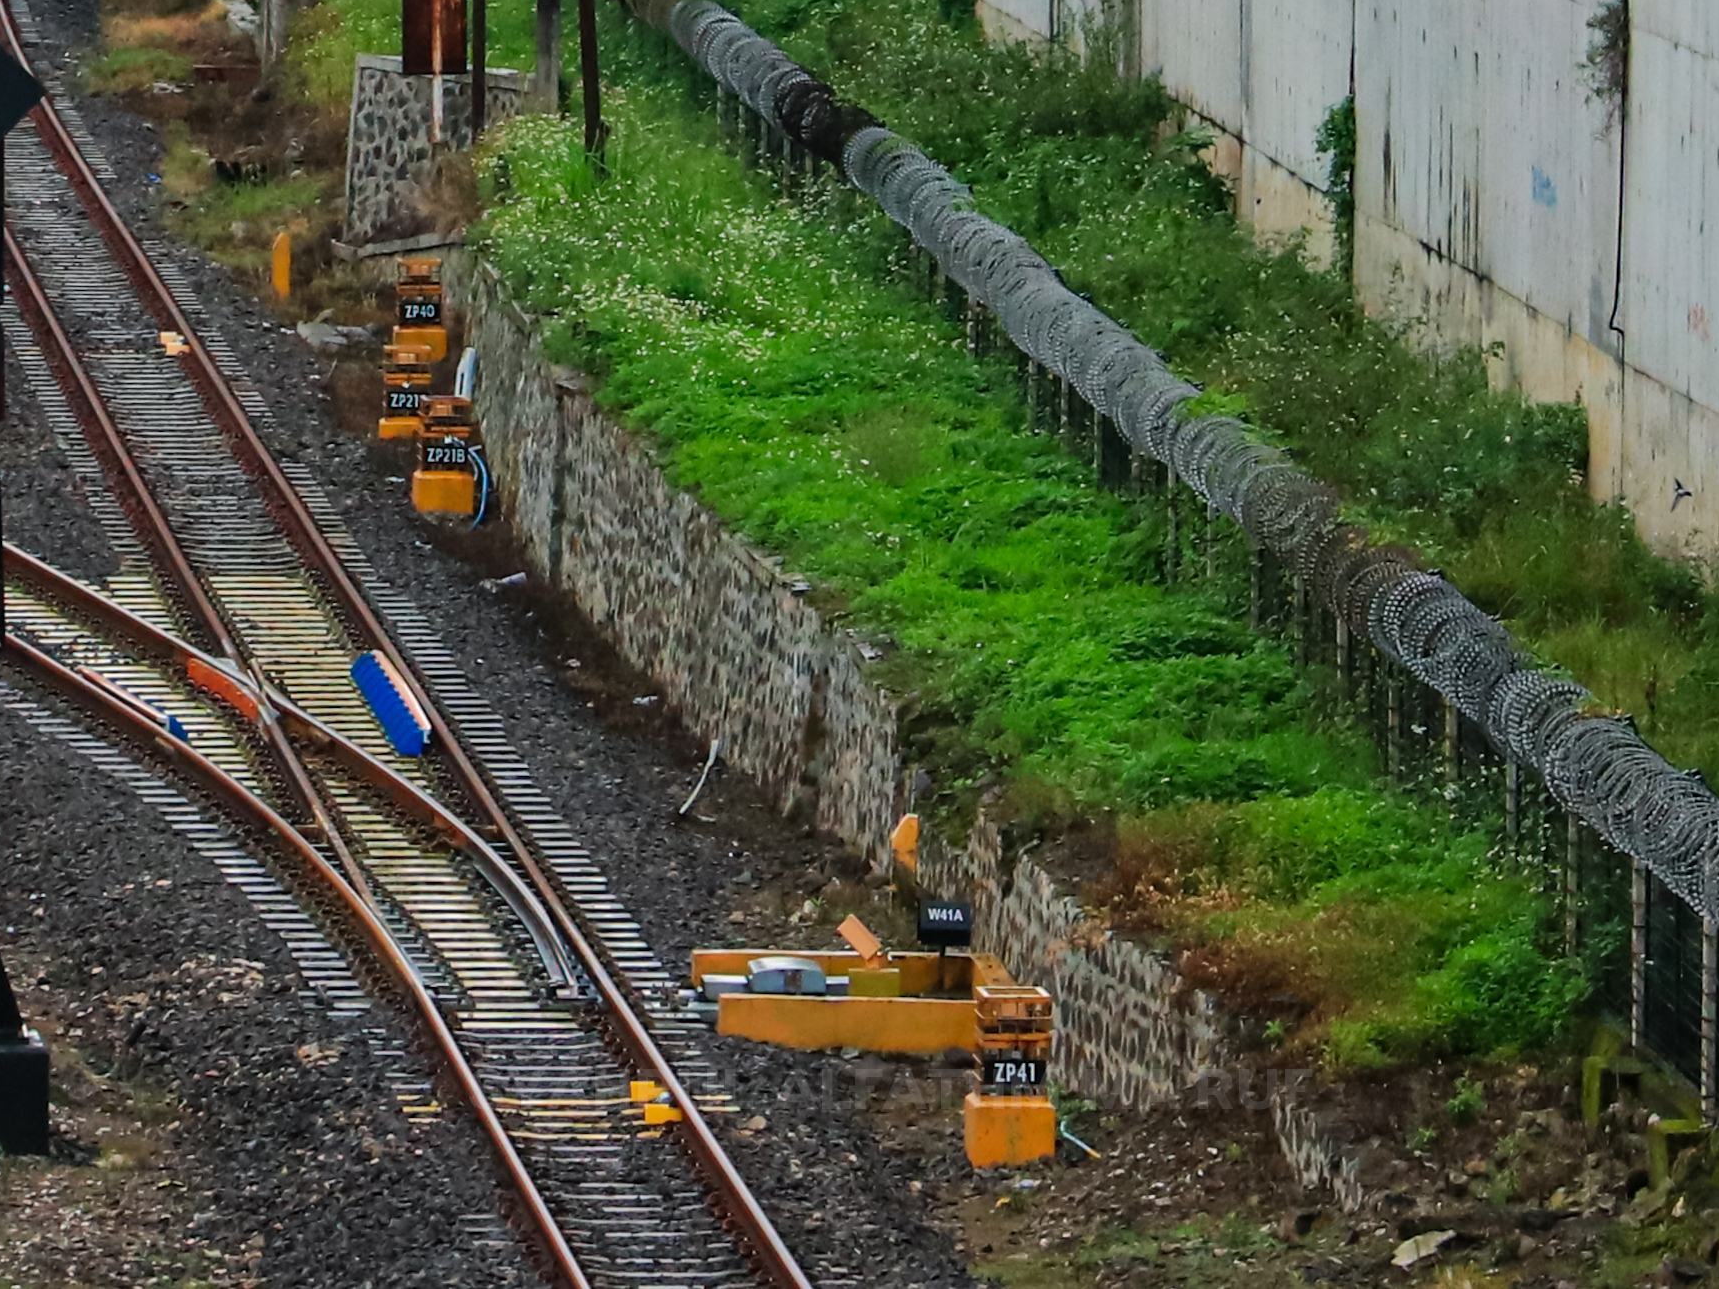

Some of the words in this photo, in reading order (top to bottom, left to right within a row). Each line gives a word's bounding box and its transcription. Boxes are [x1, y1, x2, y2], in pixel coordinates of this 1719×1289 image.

[404, 304, 435, 319] ZP40
[427, 447, 465, 463] ZP21B
[927, 907, 964, 922] W41A
[994, 1062, 1036, 1083] ZP41
